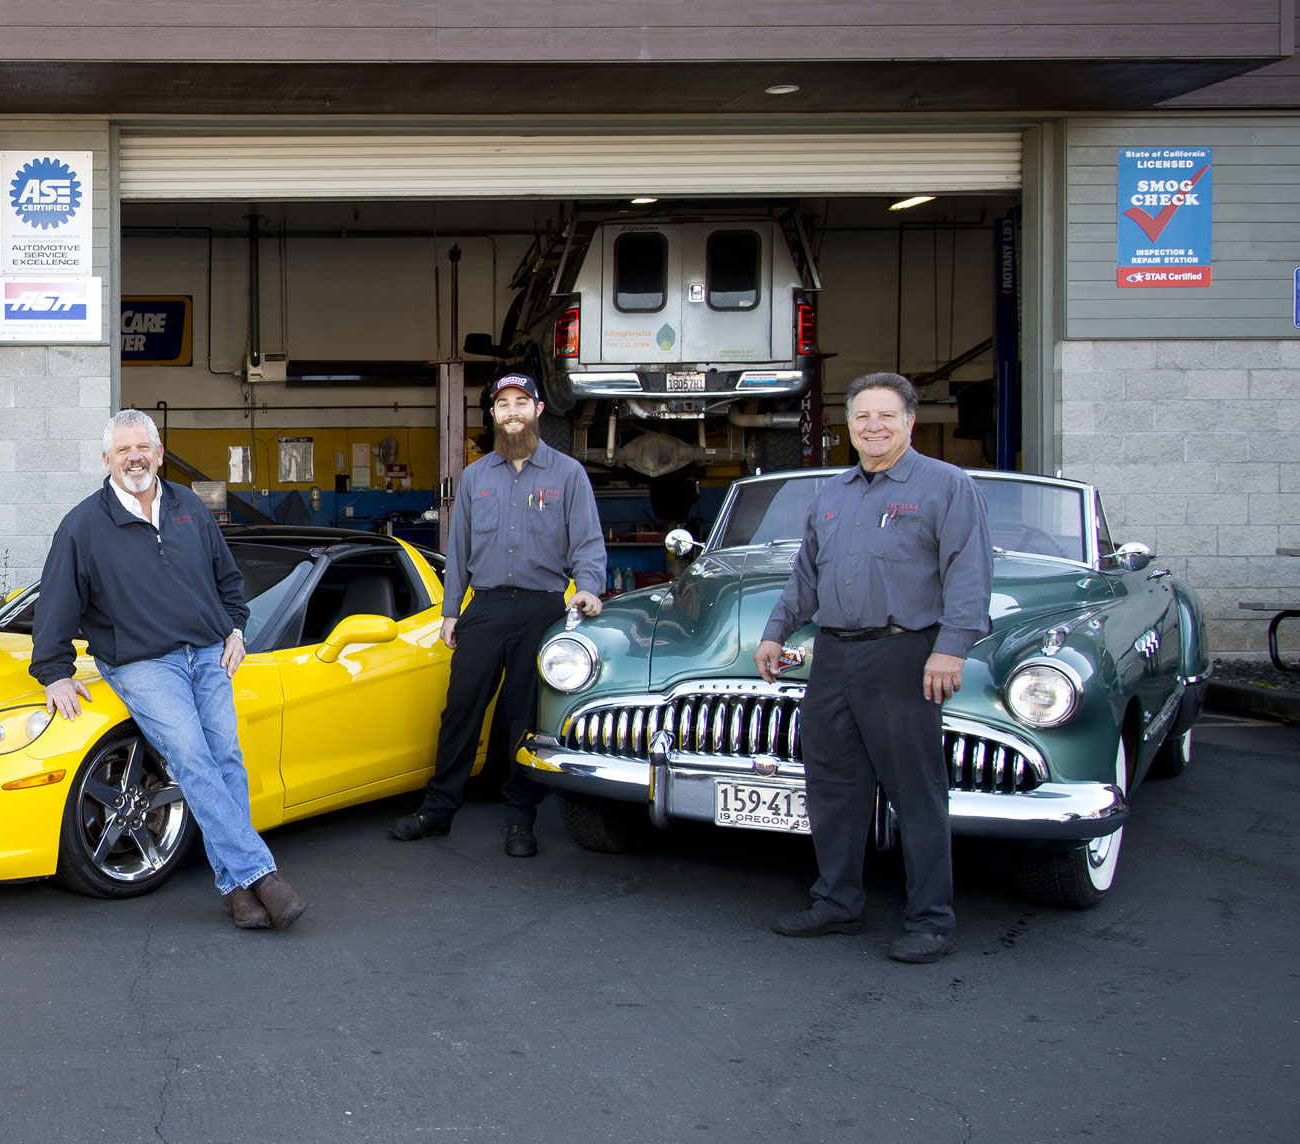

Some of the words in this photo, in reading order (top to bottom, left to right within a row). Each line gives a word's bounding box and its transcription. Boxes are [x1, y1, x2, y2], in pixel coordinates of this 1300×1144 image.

[1125, 150, 1149, 158] State
[1137, 160, 1194, 168] LICENSED
[18, 179, 71, 204] ASE
[1137, 180, 1193, 192] SMOG
[1131, 194, 1200, 206] CHECK
[21, 204, 70, 212] CERTIFIED
[1002, 245, 1013, 288] ROTARY
[1145, 273, 1167, 281] STAR
[1168, 272, 1202, 281] Certified
[121, 310, 167, 333] CARE
[603, 329, 651, 338] Maganda
[721, 787, 807, 818] 159-413
[735, 813, 789, 826] OREGON
